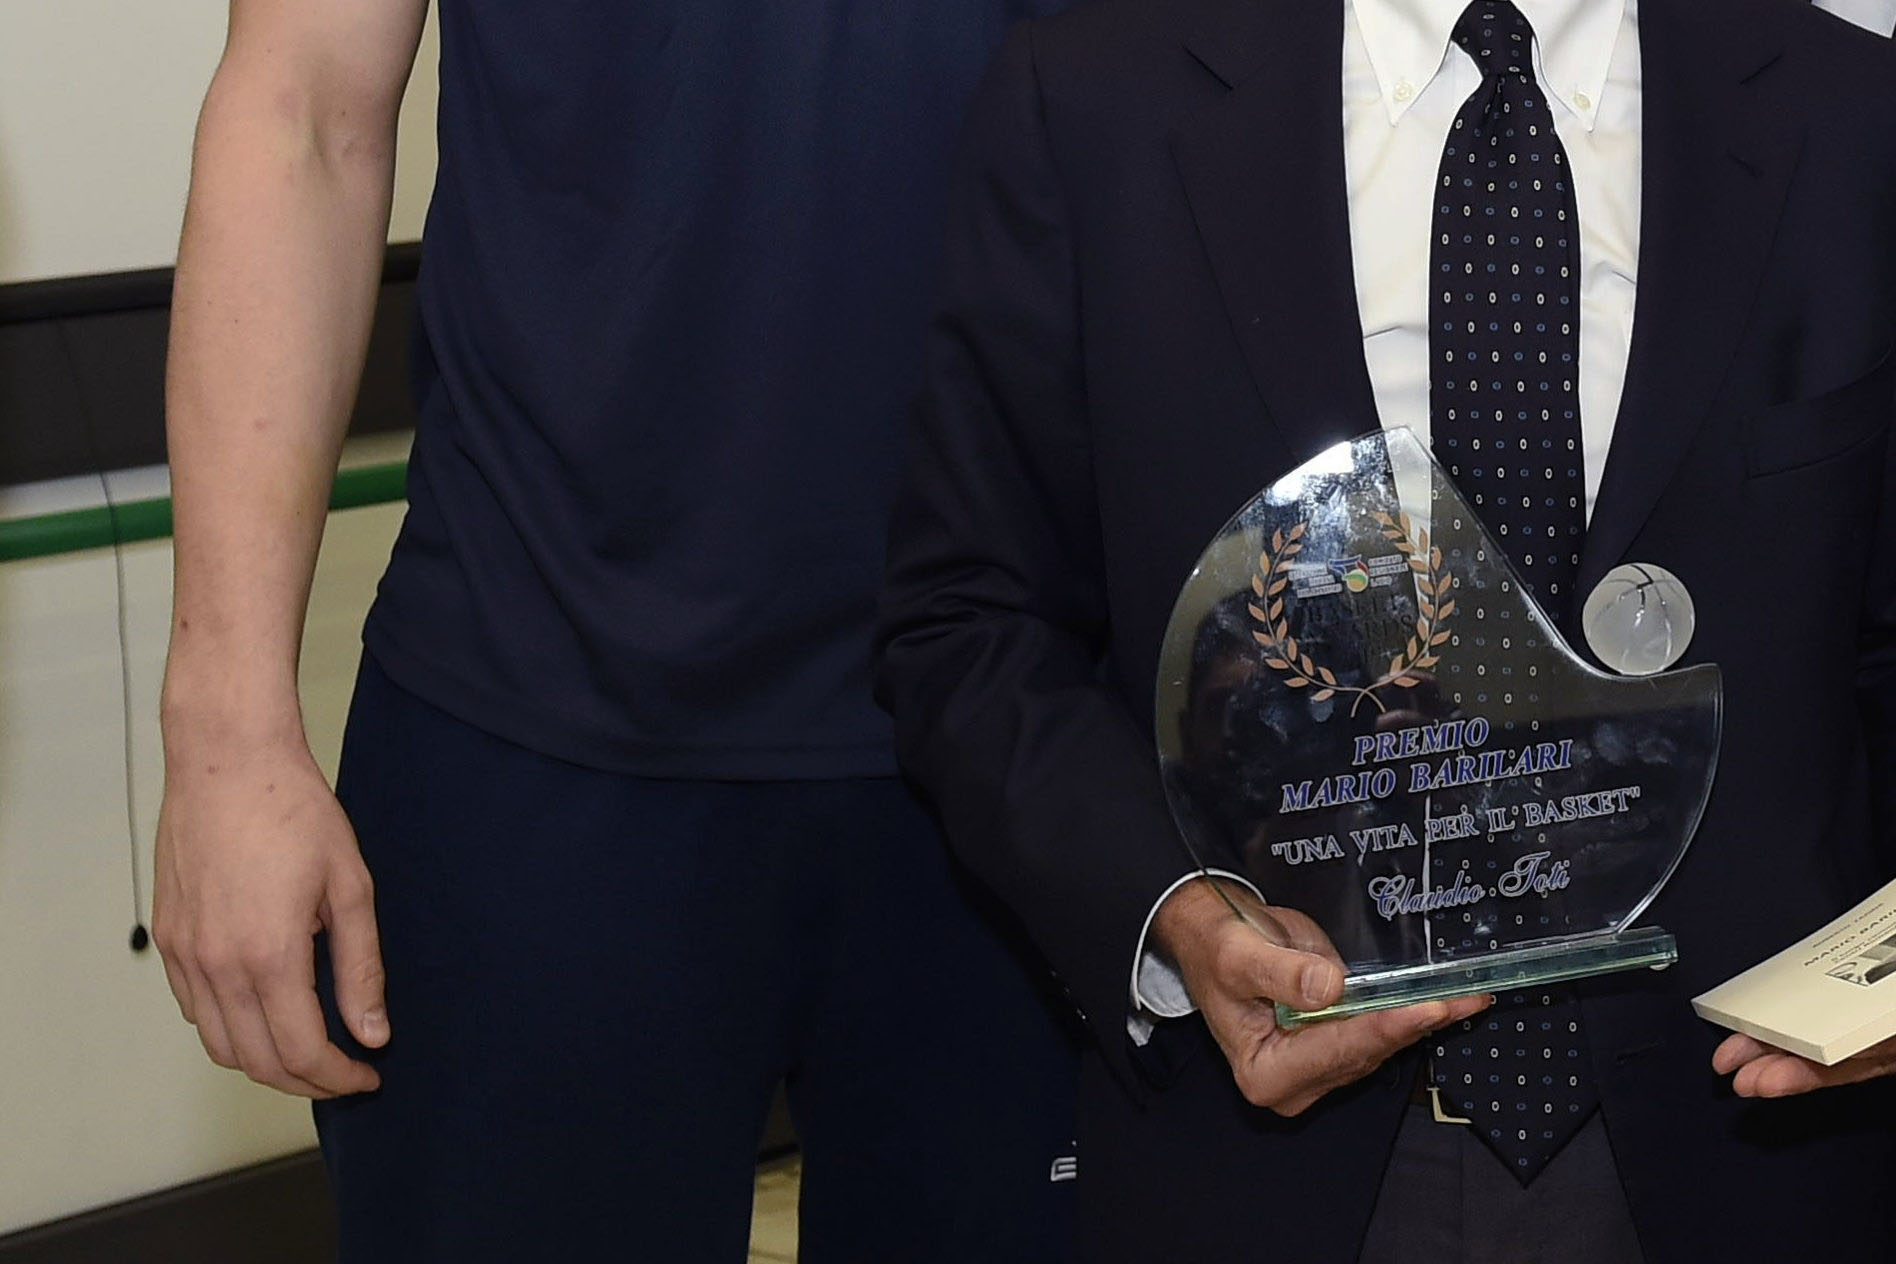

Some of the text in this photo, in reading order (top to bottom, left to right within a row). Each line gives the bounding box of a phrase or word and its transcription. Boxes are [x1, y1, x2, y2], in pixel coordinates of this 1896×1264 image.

[1279, 740, 1573, 813] MARIO BARILARI
[1352, 717, 1489, 765] PREMIO
[1271, 787, 1641, 865] "UNA VITA PER IL BASKET"
[1368, 851, 1571, 920] Claudio Toti
